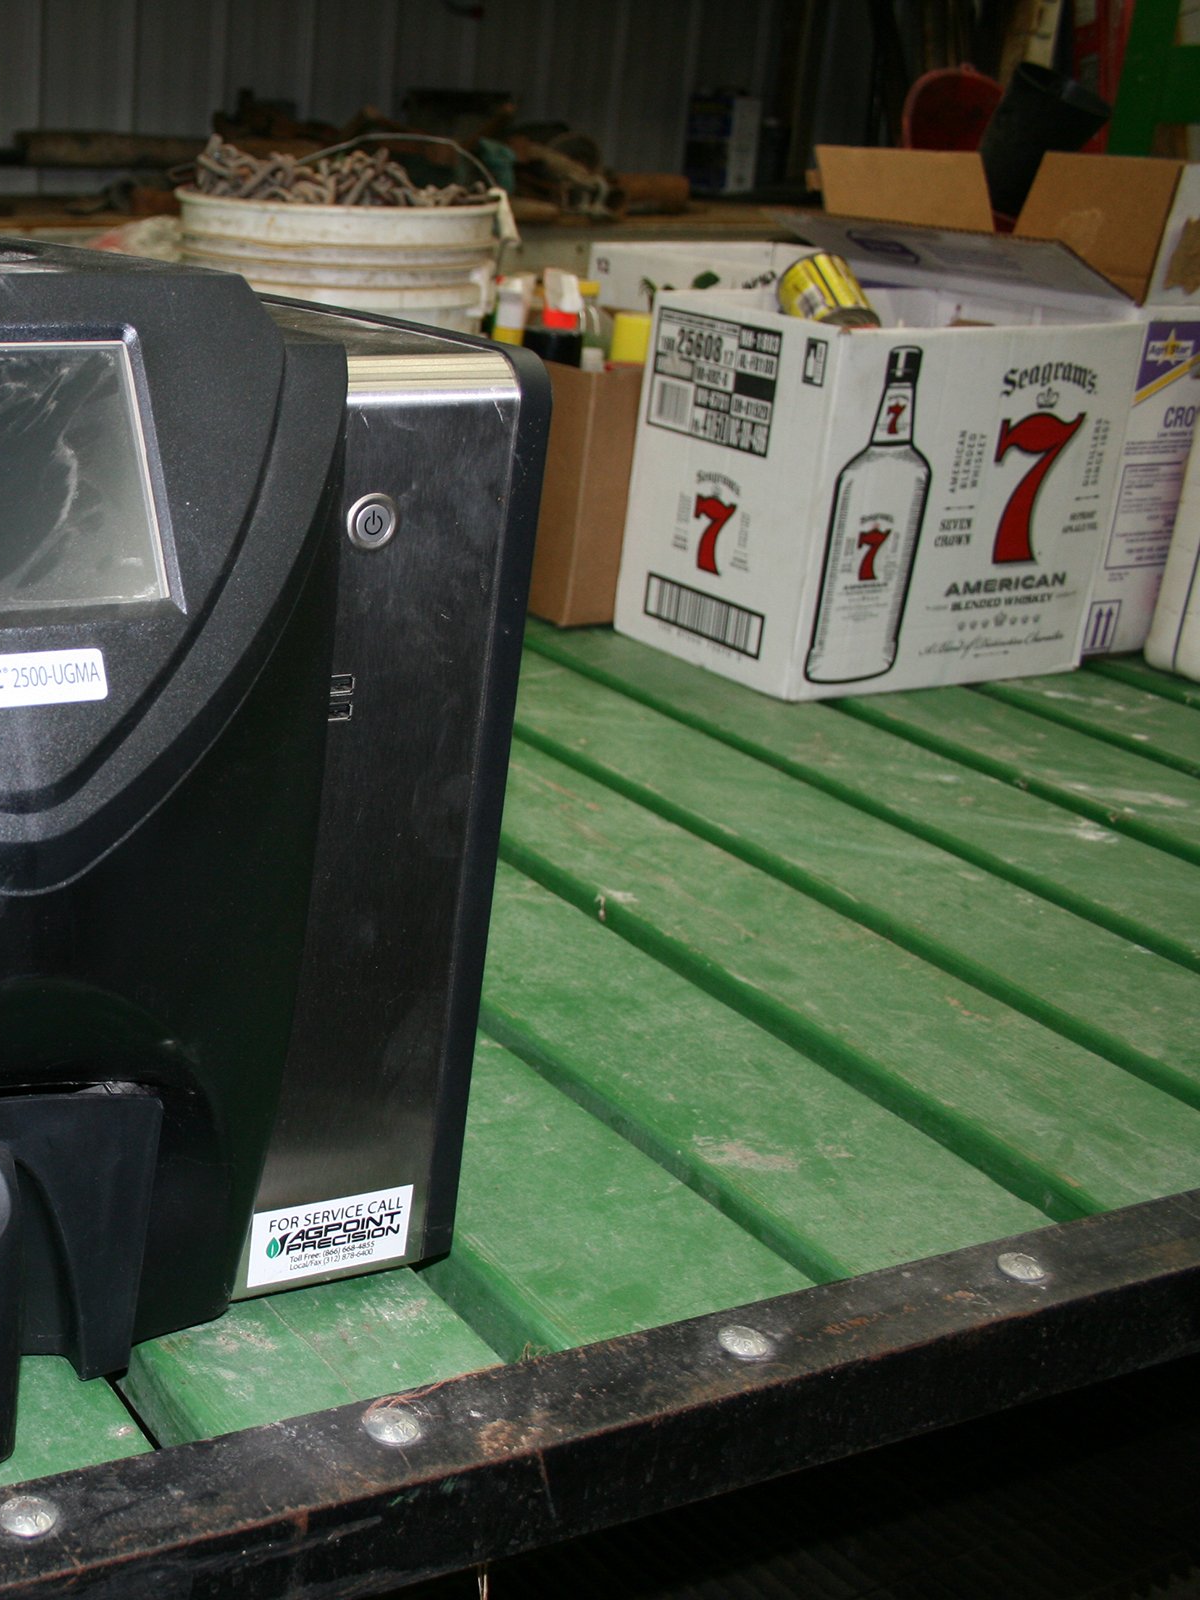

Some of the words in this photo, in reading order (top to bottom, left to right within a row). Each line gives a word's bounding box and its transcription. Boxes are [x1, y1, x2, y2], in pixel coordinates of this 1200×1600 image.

[1000, 360, 1098, 397] Seagram's
[886, 401, 906, 434] 7
[1163, 405, 1200, 429] CRO
[991, 411, 1087, 565] 7
[694, 493, 738, 576] 7
[939, 517, 973, 532] SEVEN
[856, 526, 892, 581] 7
[934, 533, 971, 548] CROWN
[944, 571, 1067, 598] AMERICAN
[950, 596, 1001, 612] BLENDED
[1004, 592, 1054, 607] WHISKEY
[11, 661, 101, 689] 2500-UGMA
[269, 1215, 300, 1233] FOR
[303, 1203, 364, 1227] SERVICE
[367, 1196, 404, 1215] CALL
[287, 1210, 402, 1244] AGPOINT
[285, 1223, 400, 1256] PRECISION
[289, 1254, 303, 1264] Toll
[289, 1259, 322, 1271] Local/Fax
